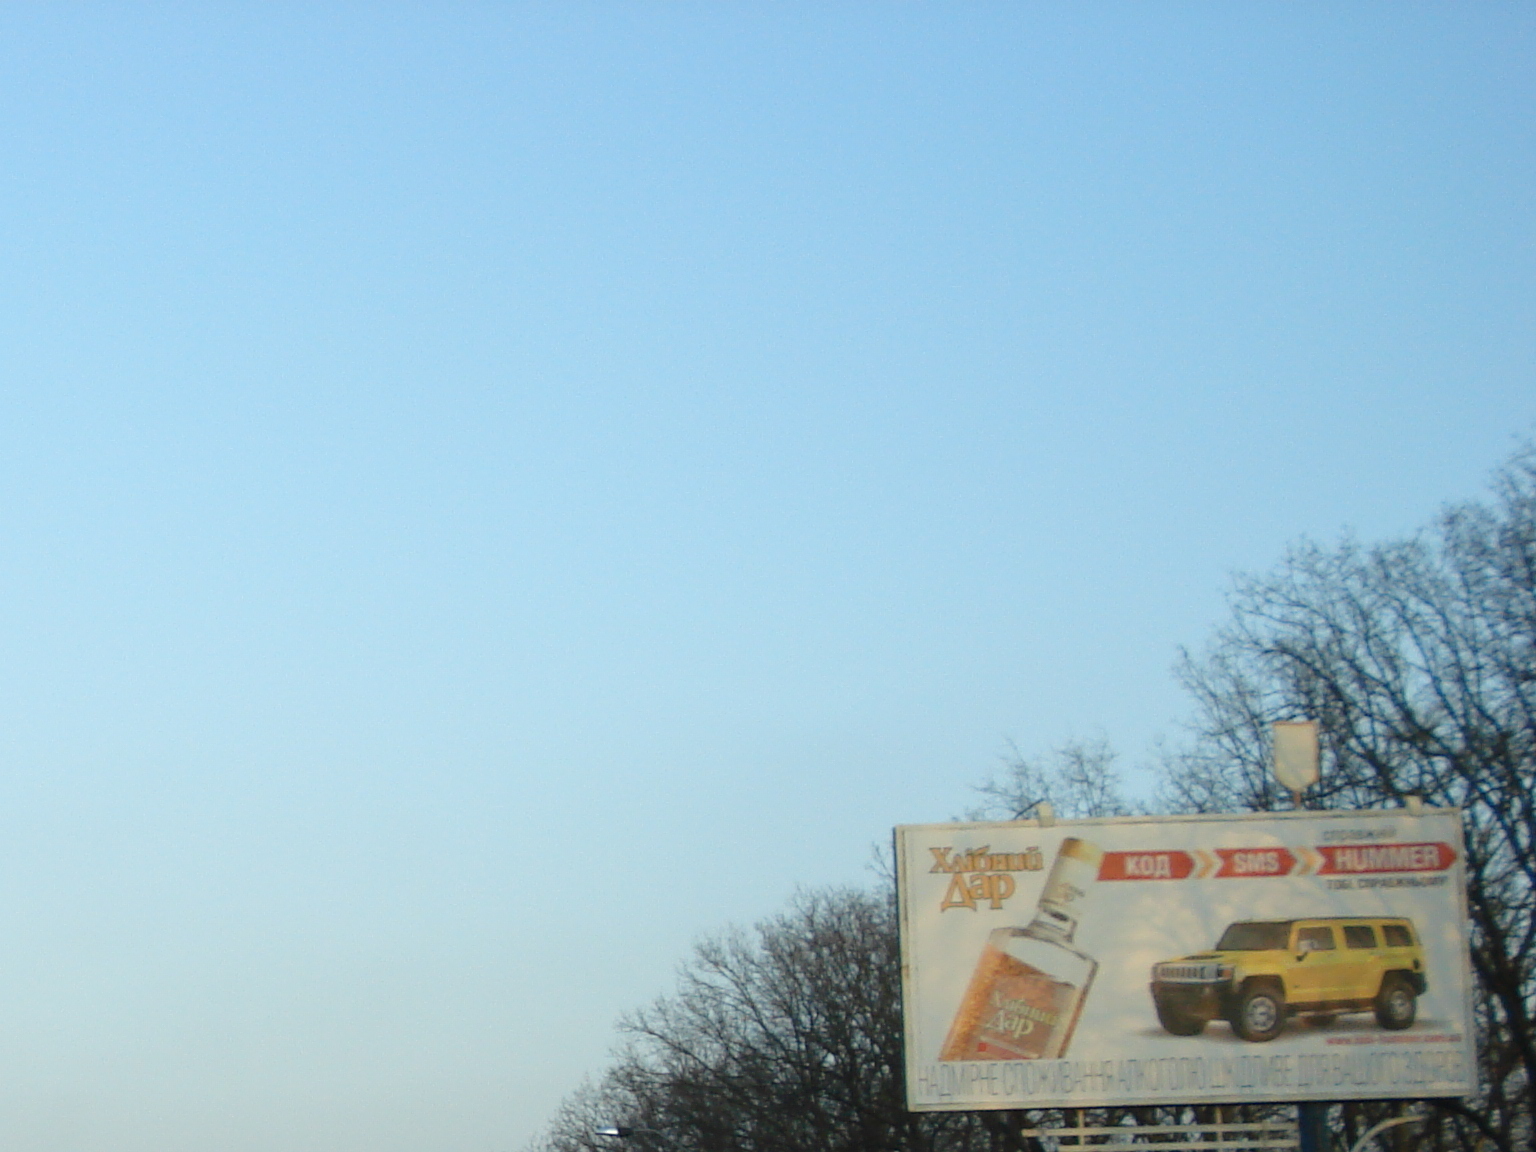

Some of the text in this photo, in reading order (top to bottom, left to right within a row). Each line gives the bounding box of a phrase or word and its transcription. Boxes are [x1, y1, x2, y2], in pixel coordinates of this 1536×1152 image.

[928, 845, 1044, 874] Хлібний
[1123, 853, 1172, 879] КОД
[1232, 850, 1280, 874] SMS
[1334, 844, 1441, 871] HUMMER
[940, 872, 1016, 913] Дар
[984, 1008, 1035, 1039] Дар
